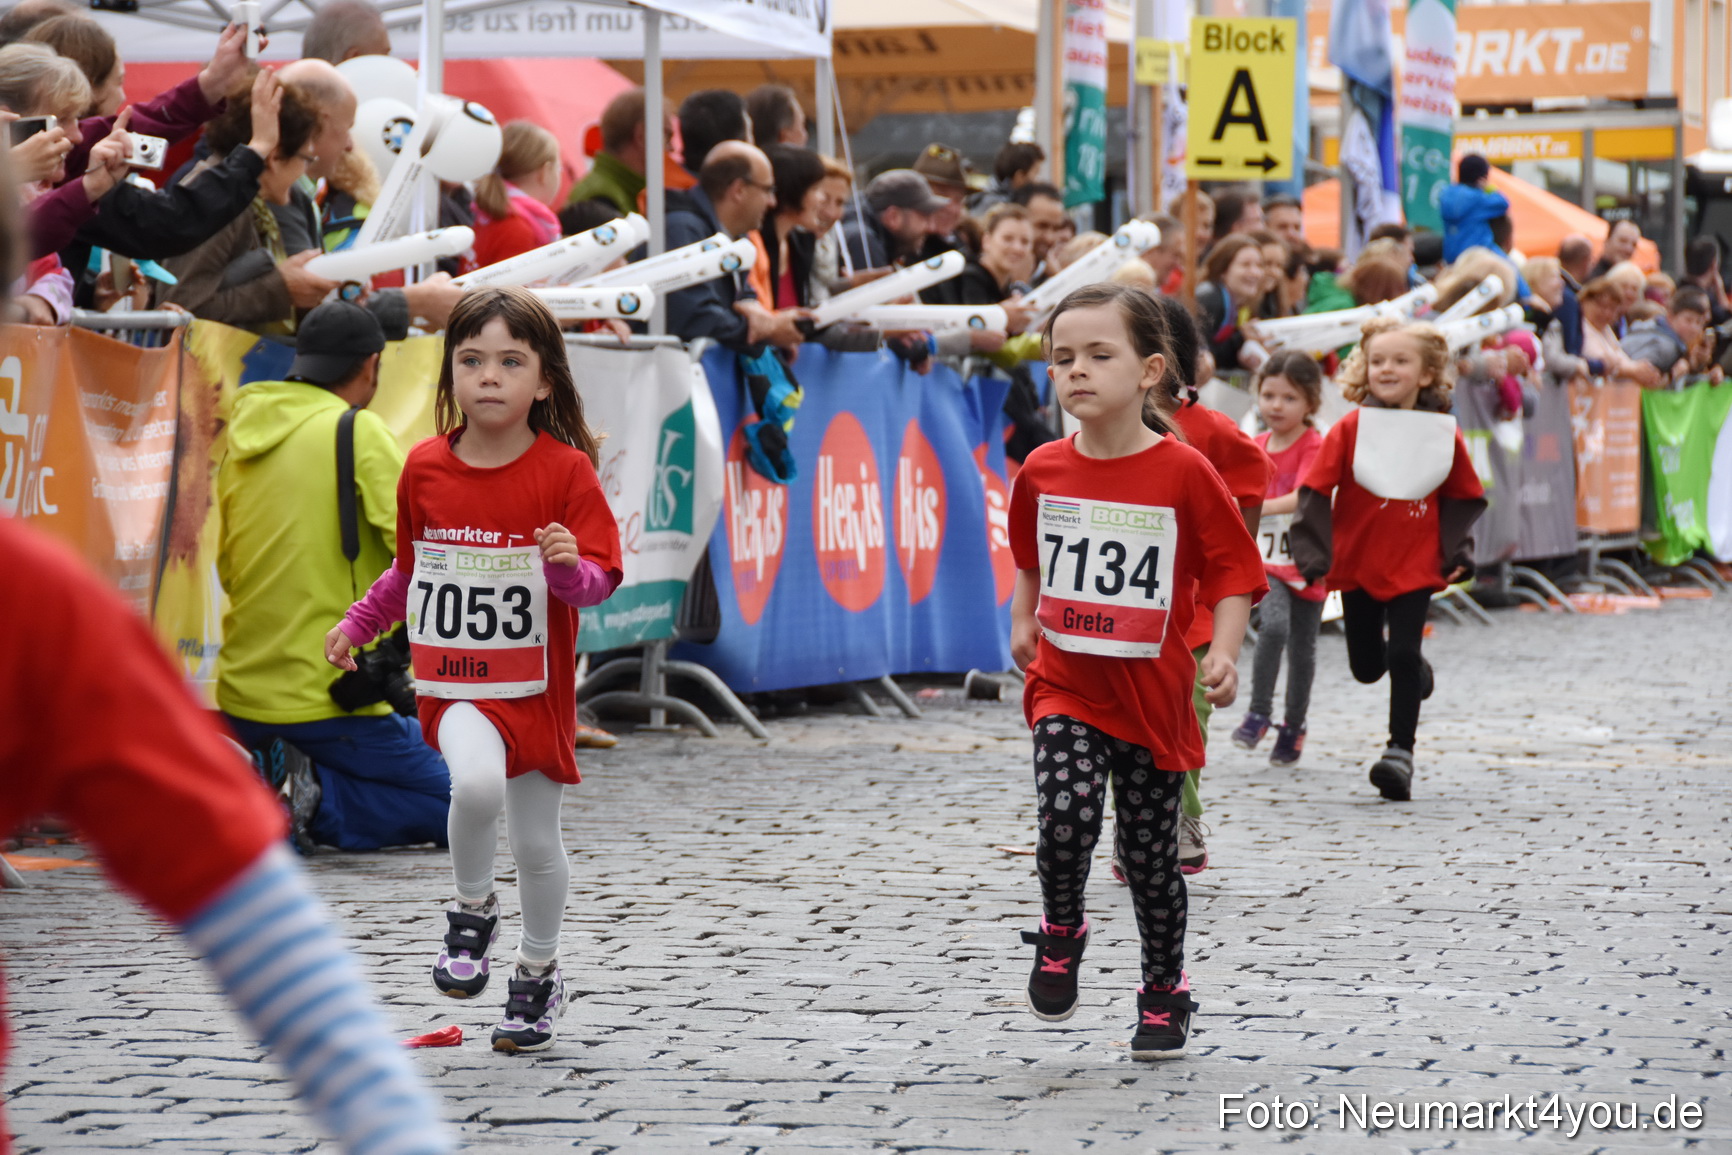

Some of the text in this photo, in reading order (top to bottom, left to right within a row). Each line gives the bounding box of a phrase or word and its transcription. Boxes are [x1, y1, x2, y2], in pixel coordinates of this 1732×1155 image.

[1204, 24, 1286, 51] Block
[1211, 67, 1269, 142] A
[1042, 512, 1081, 524] NeuerMarkt
[1091, 506, 1164, 531] BOCK
[1263, 531, 1292, 560] 74
[456, 552, 532, 571] BOCK
[1044, 533, 1160, 600] 7134
[417, 580, 533, 641] 7053
[1063, 607, 1114, 634] Greta
[437, 655, 488, 678] Julia
